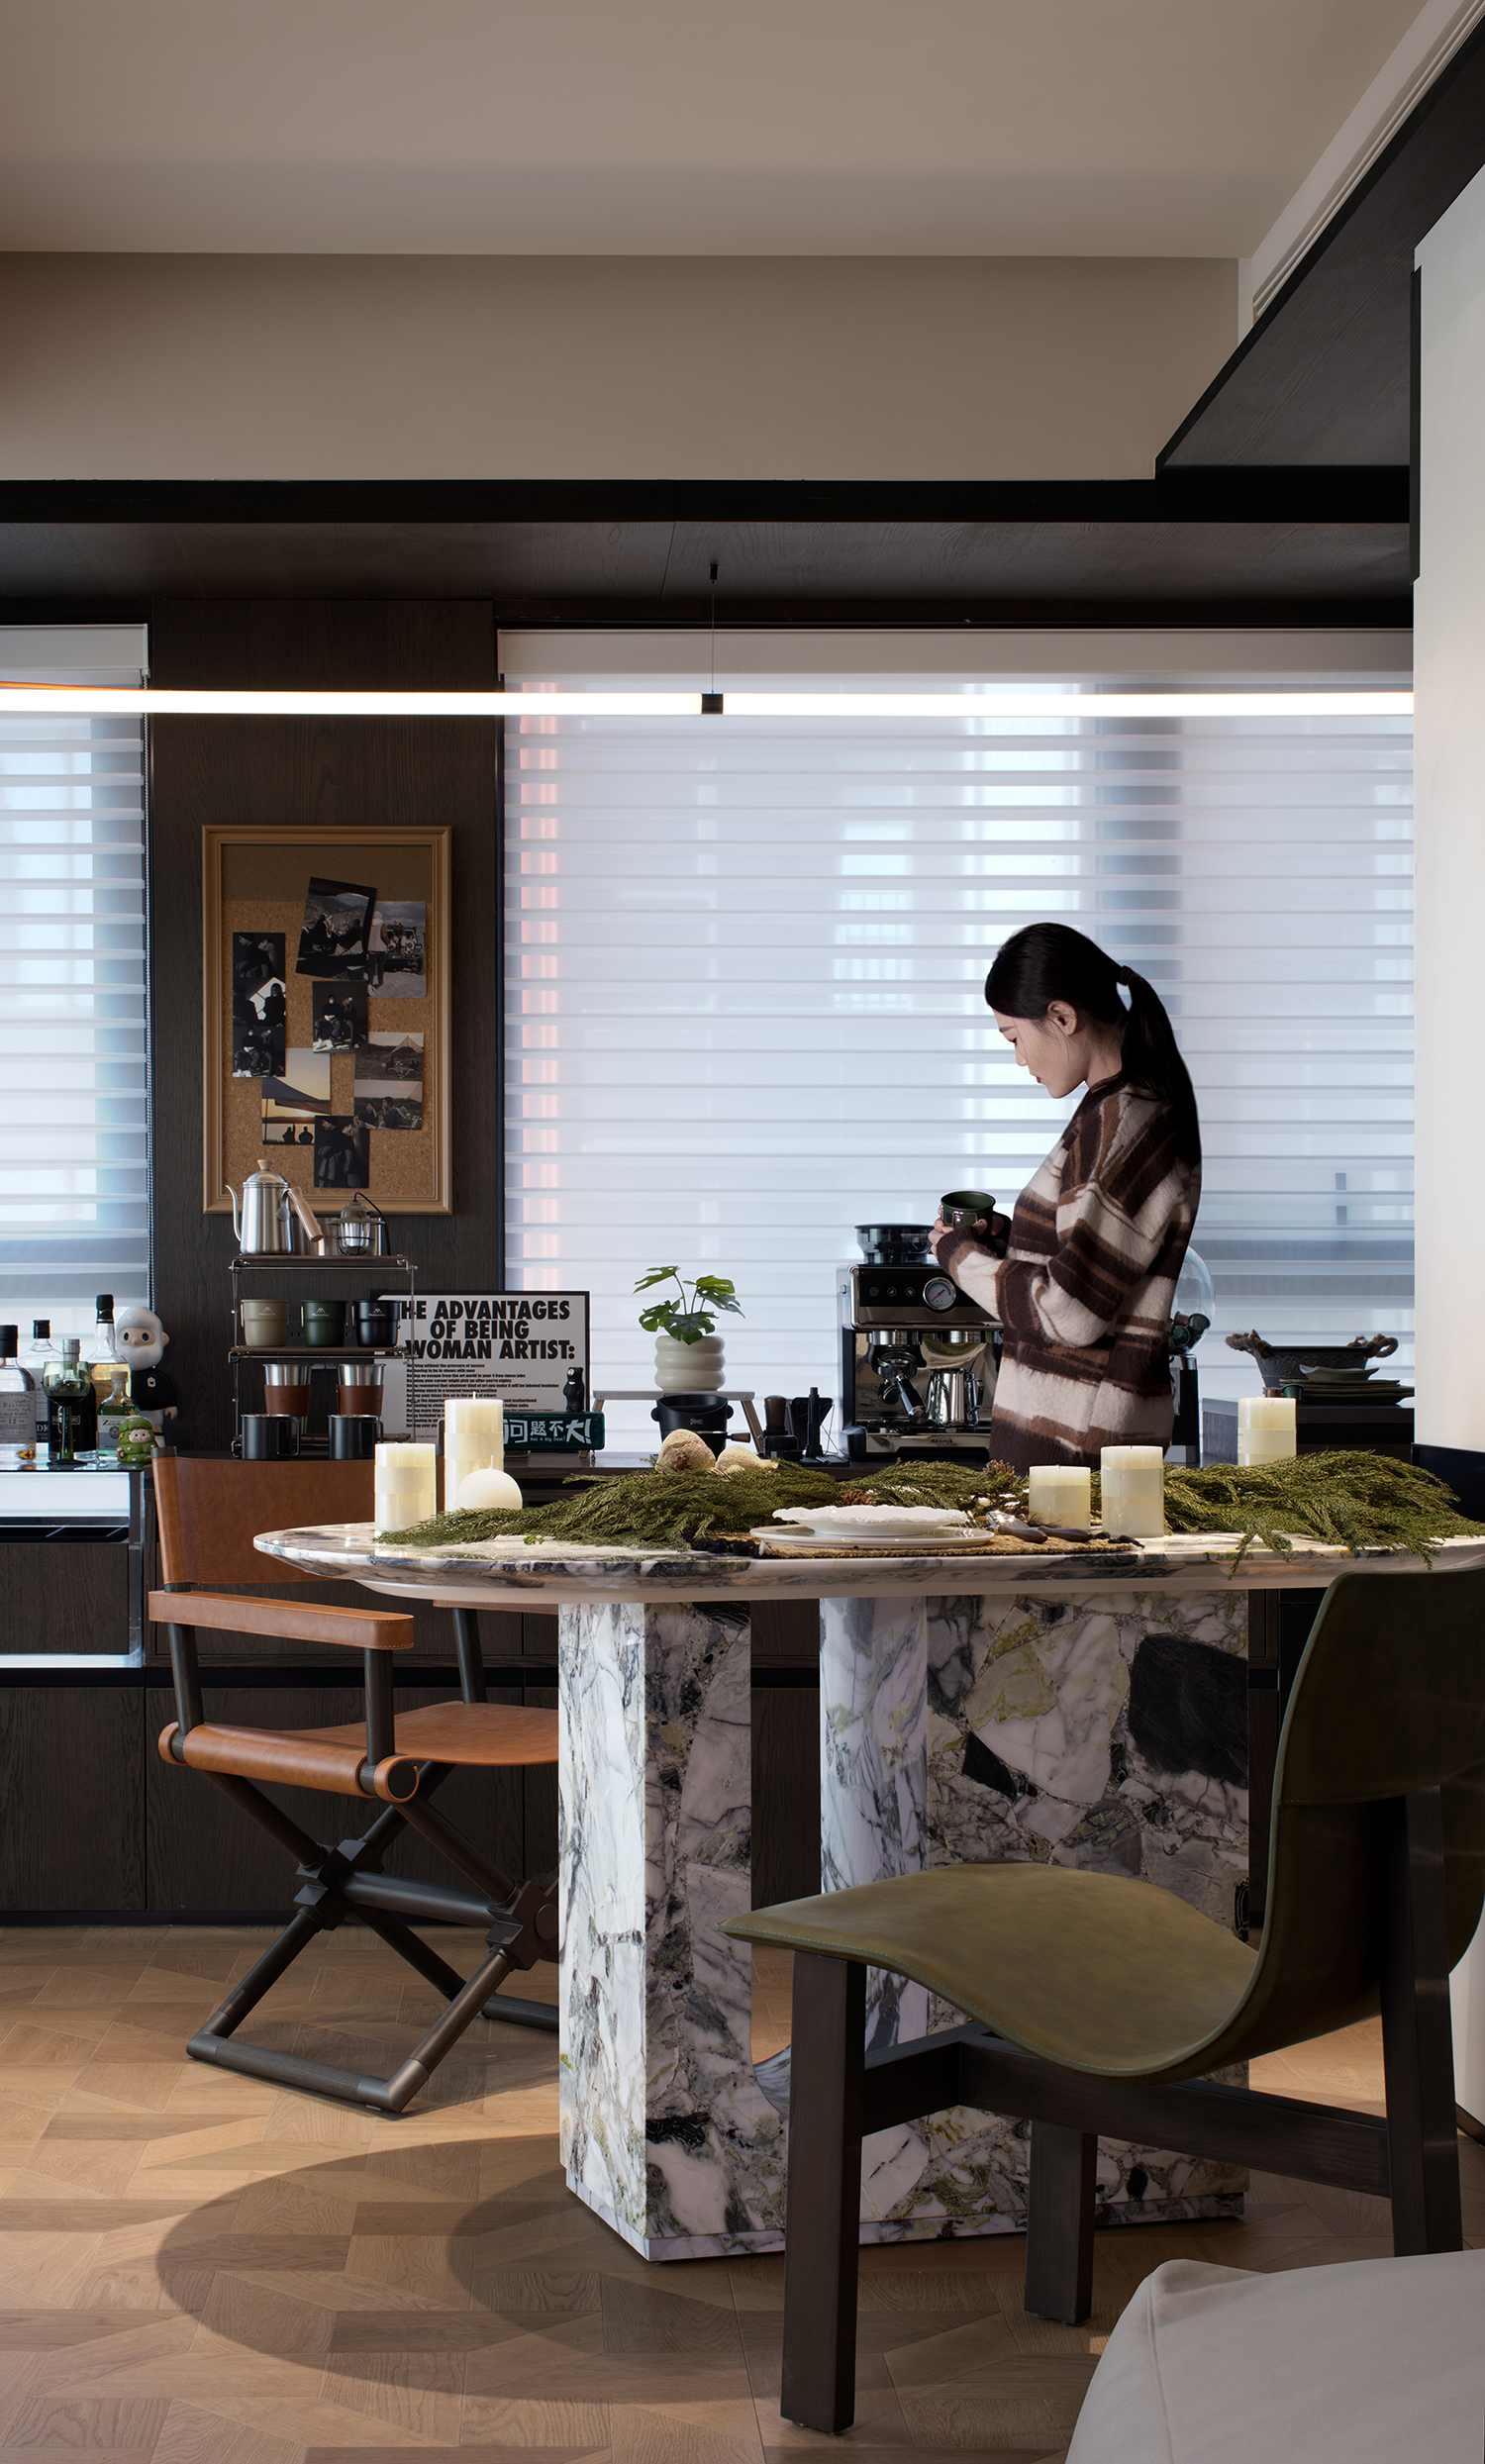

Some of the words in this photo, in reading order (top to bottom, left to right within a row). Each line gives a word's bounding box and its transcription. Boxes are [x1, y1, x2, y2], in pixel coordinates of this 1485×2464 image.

[400, 1301, 427, 1320] HE
[434, 1301, 570, 1320] ADVANTAGES
[430, 1320, 456, 1339] OF
[464, 1321, 530, 1339] BEING
[405, 1339, 492, 1359] WOMAN
[499, 1339, 575, 1359] ARTIST:
